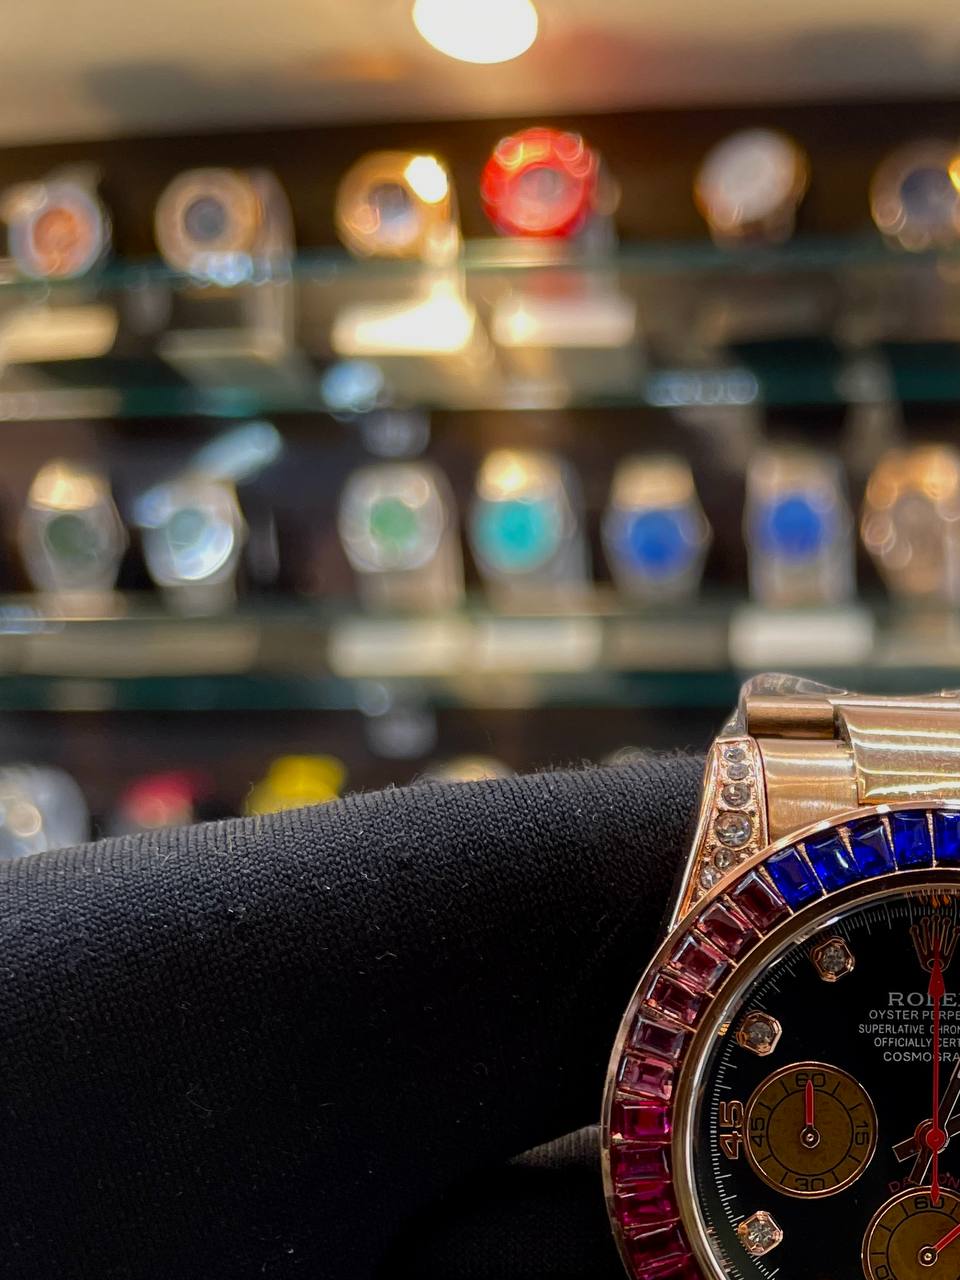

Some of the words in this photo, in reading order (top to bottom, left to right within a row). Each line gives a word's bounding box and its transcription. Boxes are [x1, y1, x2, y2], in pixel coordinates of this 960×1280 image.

[868, 1010, 919, 1020] OYSTER
[858, 1023, 925, 1034] SUPERLATIVE
[873, 1037, 932, 1047] OFFICIALLY
[719, 1100, 745, 1160] 45
[750, 1116, 767, 1147] 45
[854, 1121, 869, 1146] 15
[795, 1177, 825, 1191] 30
